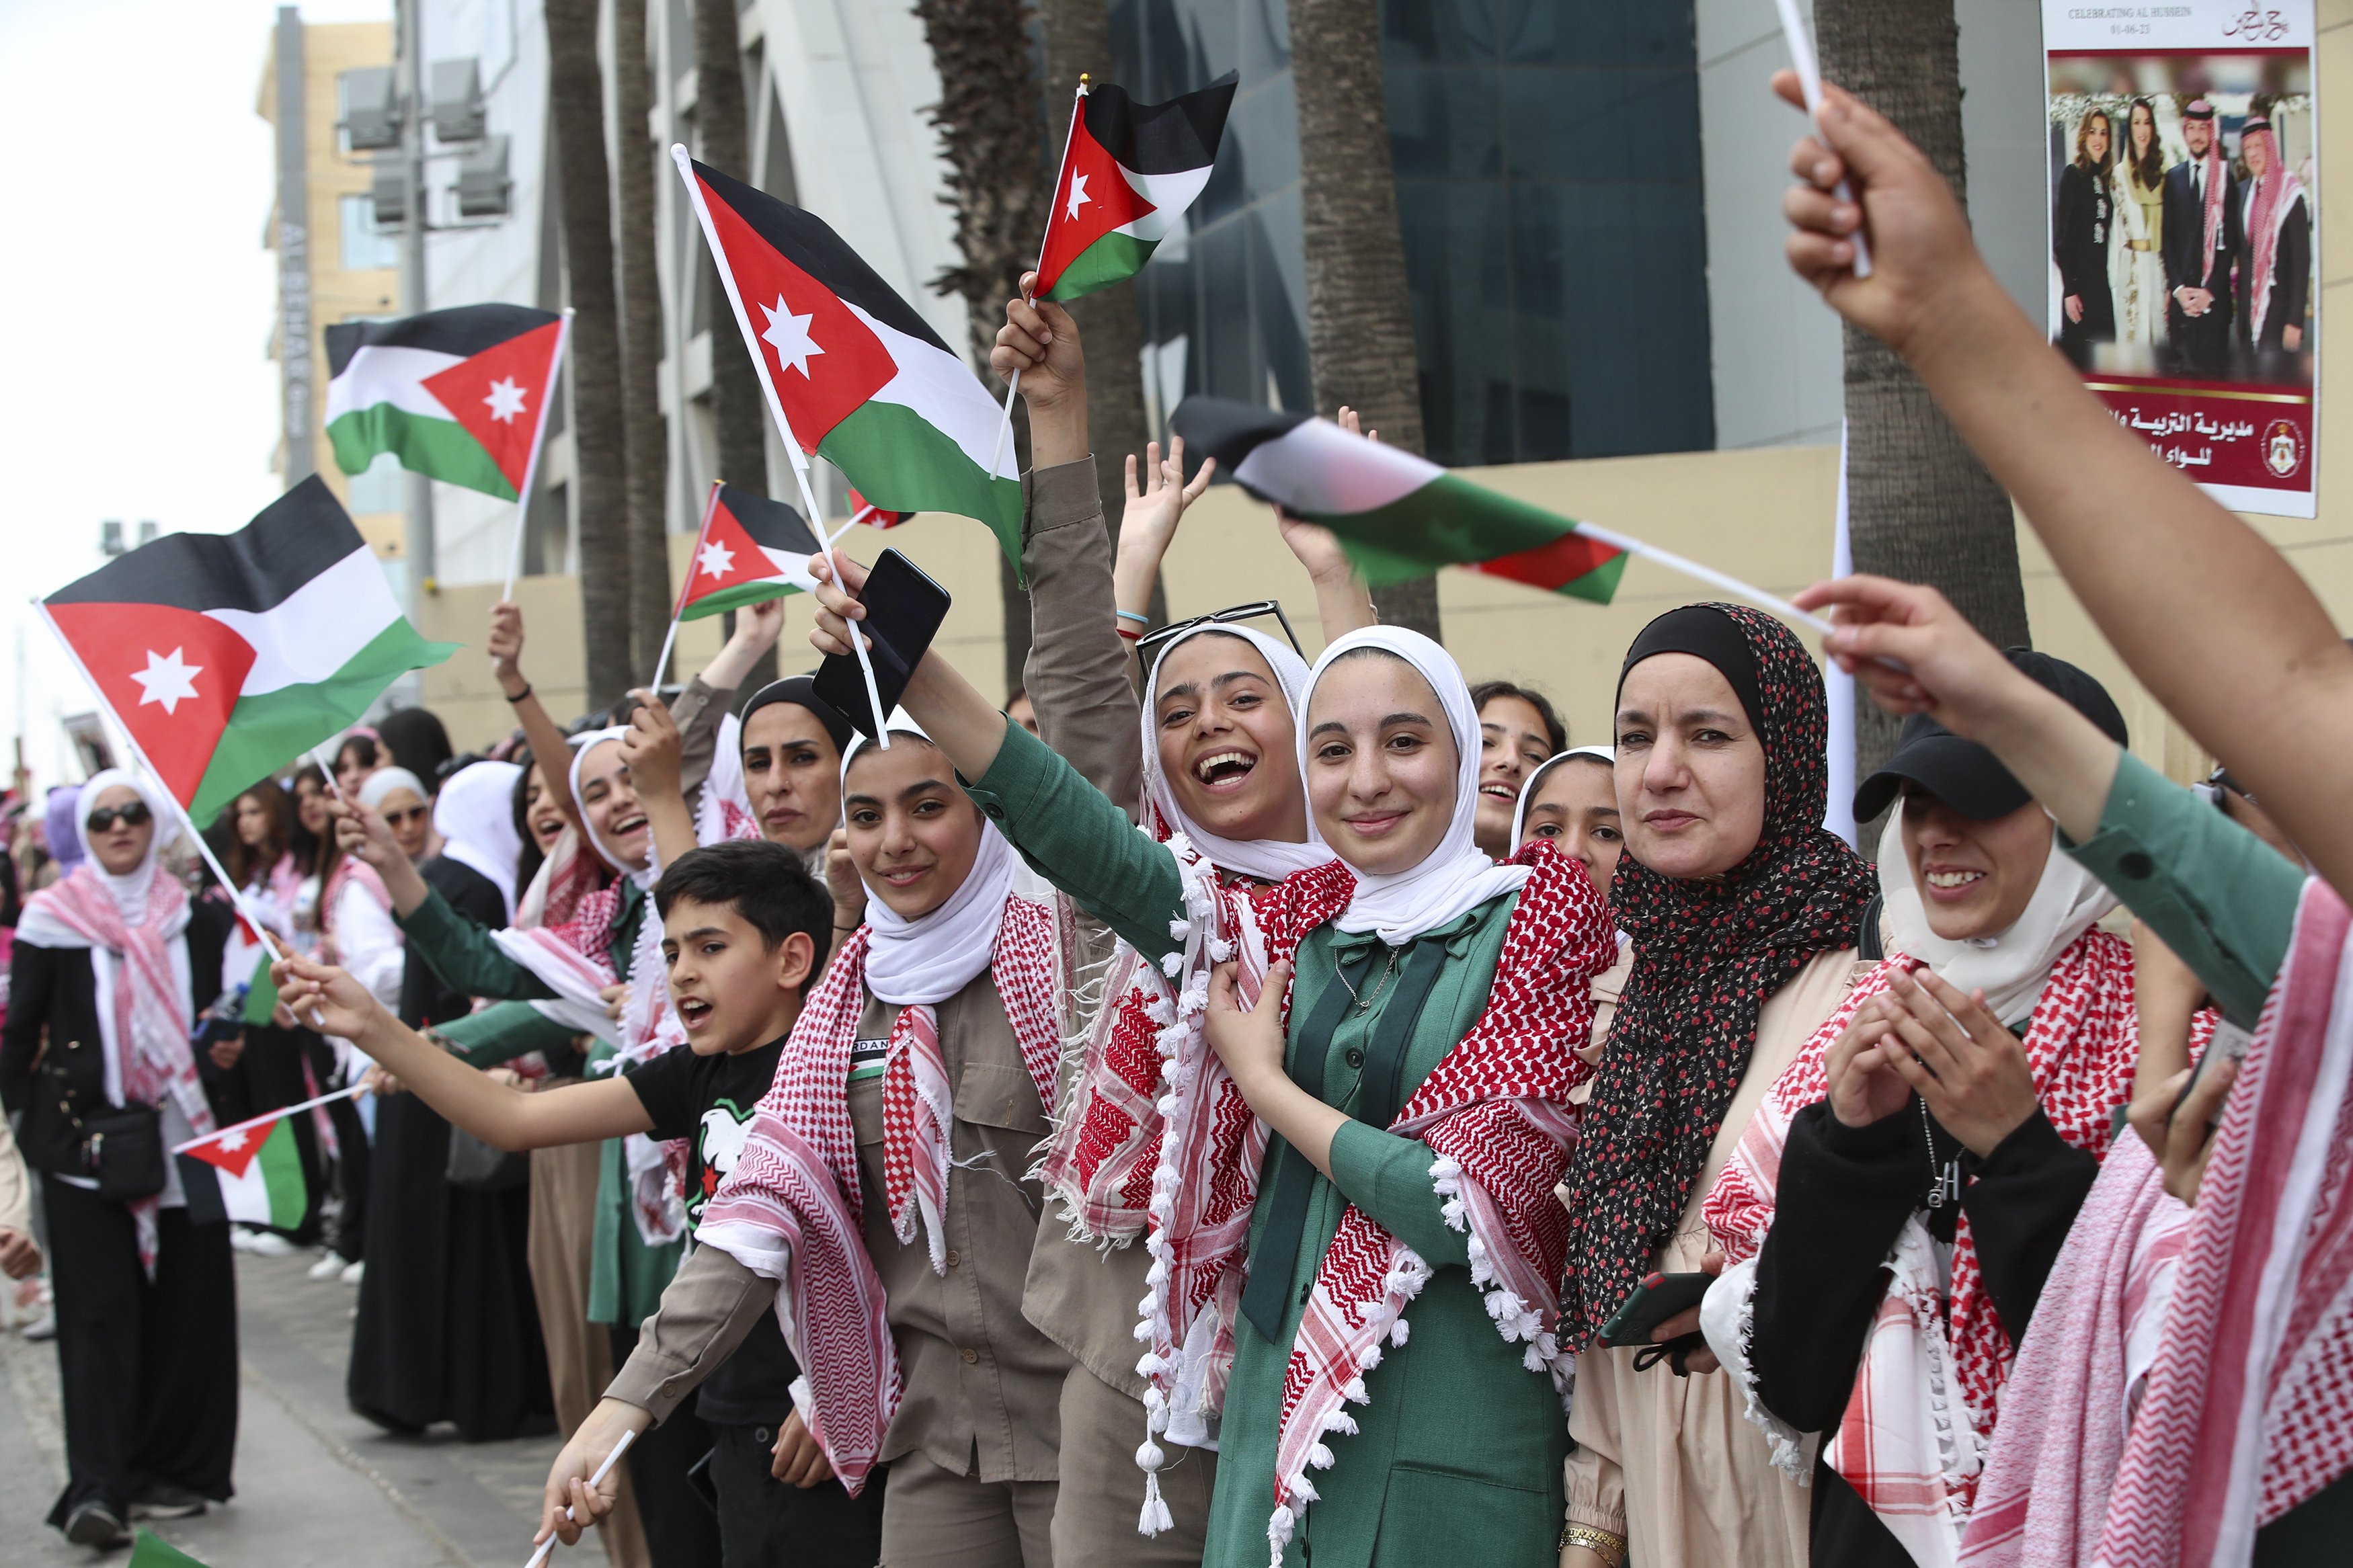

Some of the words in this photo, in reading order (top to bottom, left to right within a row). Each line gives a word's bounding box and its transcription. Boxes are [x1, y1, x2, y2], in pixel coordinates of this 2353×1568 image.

[2068, 7, 2134, 19] CELEBRATING
[2135, 7, 2148, 18] AL
[2150, 6, 2192, 18] HUSSEIN
[2110, 24, 2150, 35] 01-06-23
[2130, 407, 2192, 437] التربية
[2194, 411, 2254, 442] مديرية
